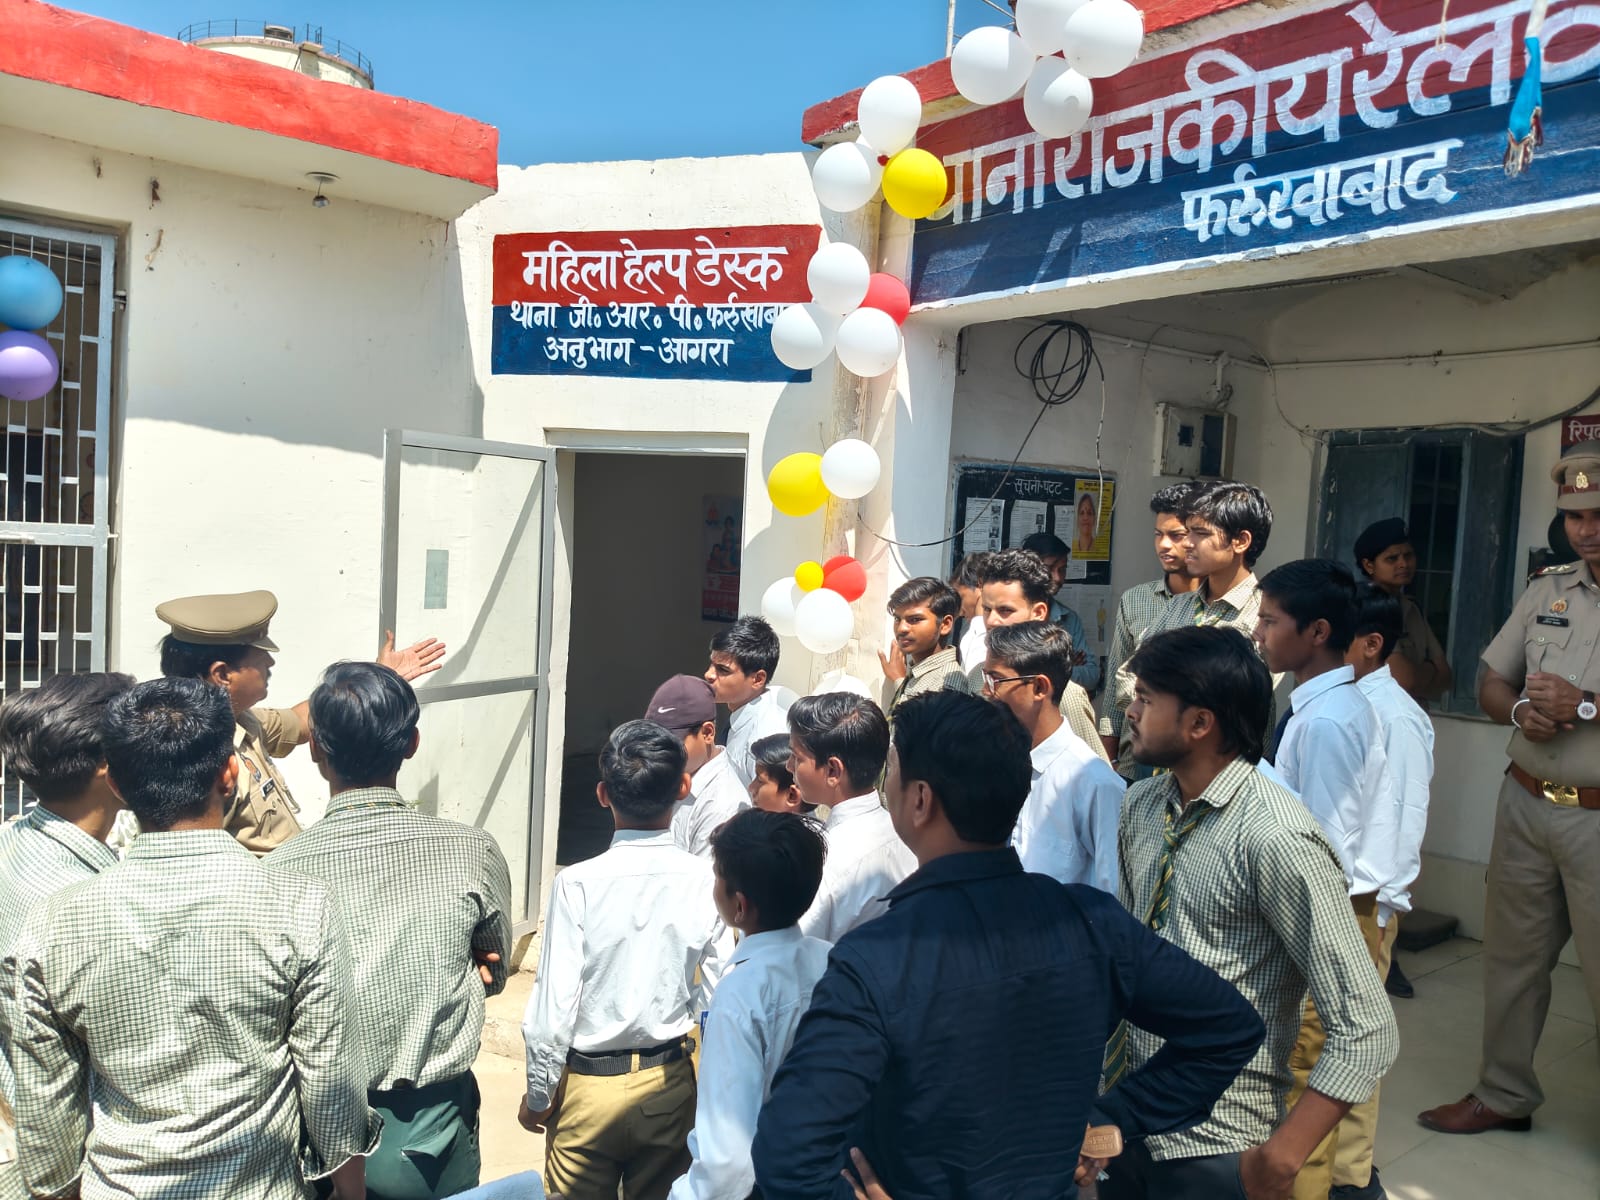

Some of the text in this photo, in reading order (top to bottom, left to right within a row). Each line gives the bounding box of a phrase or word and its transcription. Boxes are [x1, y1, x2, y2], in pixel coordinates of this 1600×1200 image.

[521, 235, 789, 296] महिला हेल्प डेस्क
[510, 300, 561, 329] थाना
[543, 336, 636, 369] अनुभाग
[658, 337, 735, 367] आगरा
